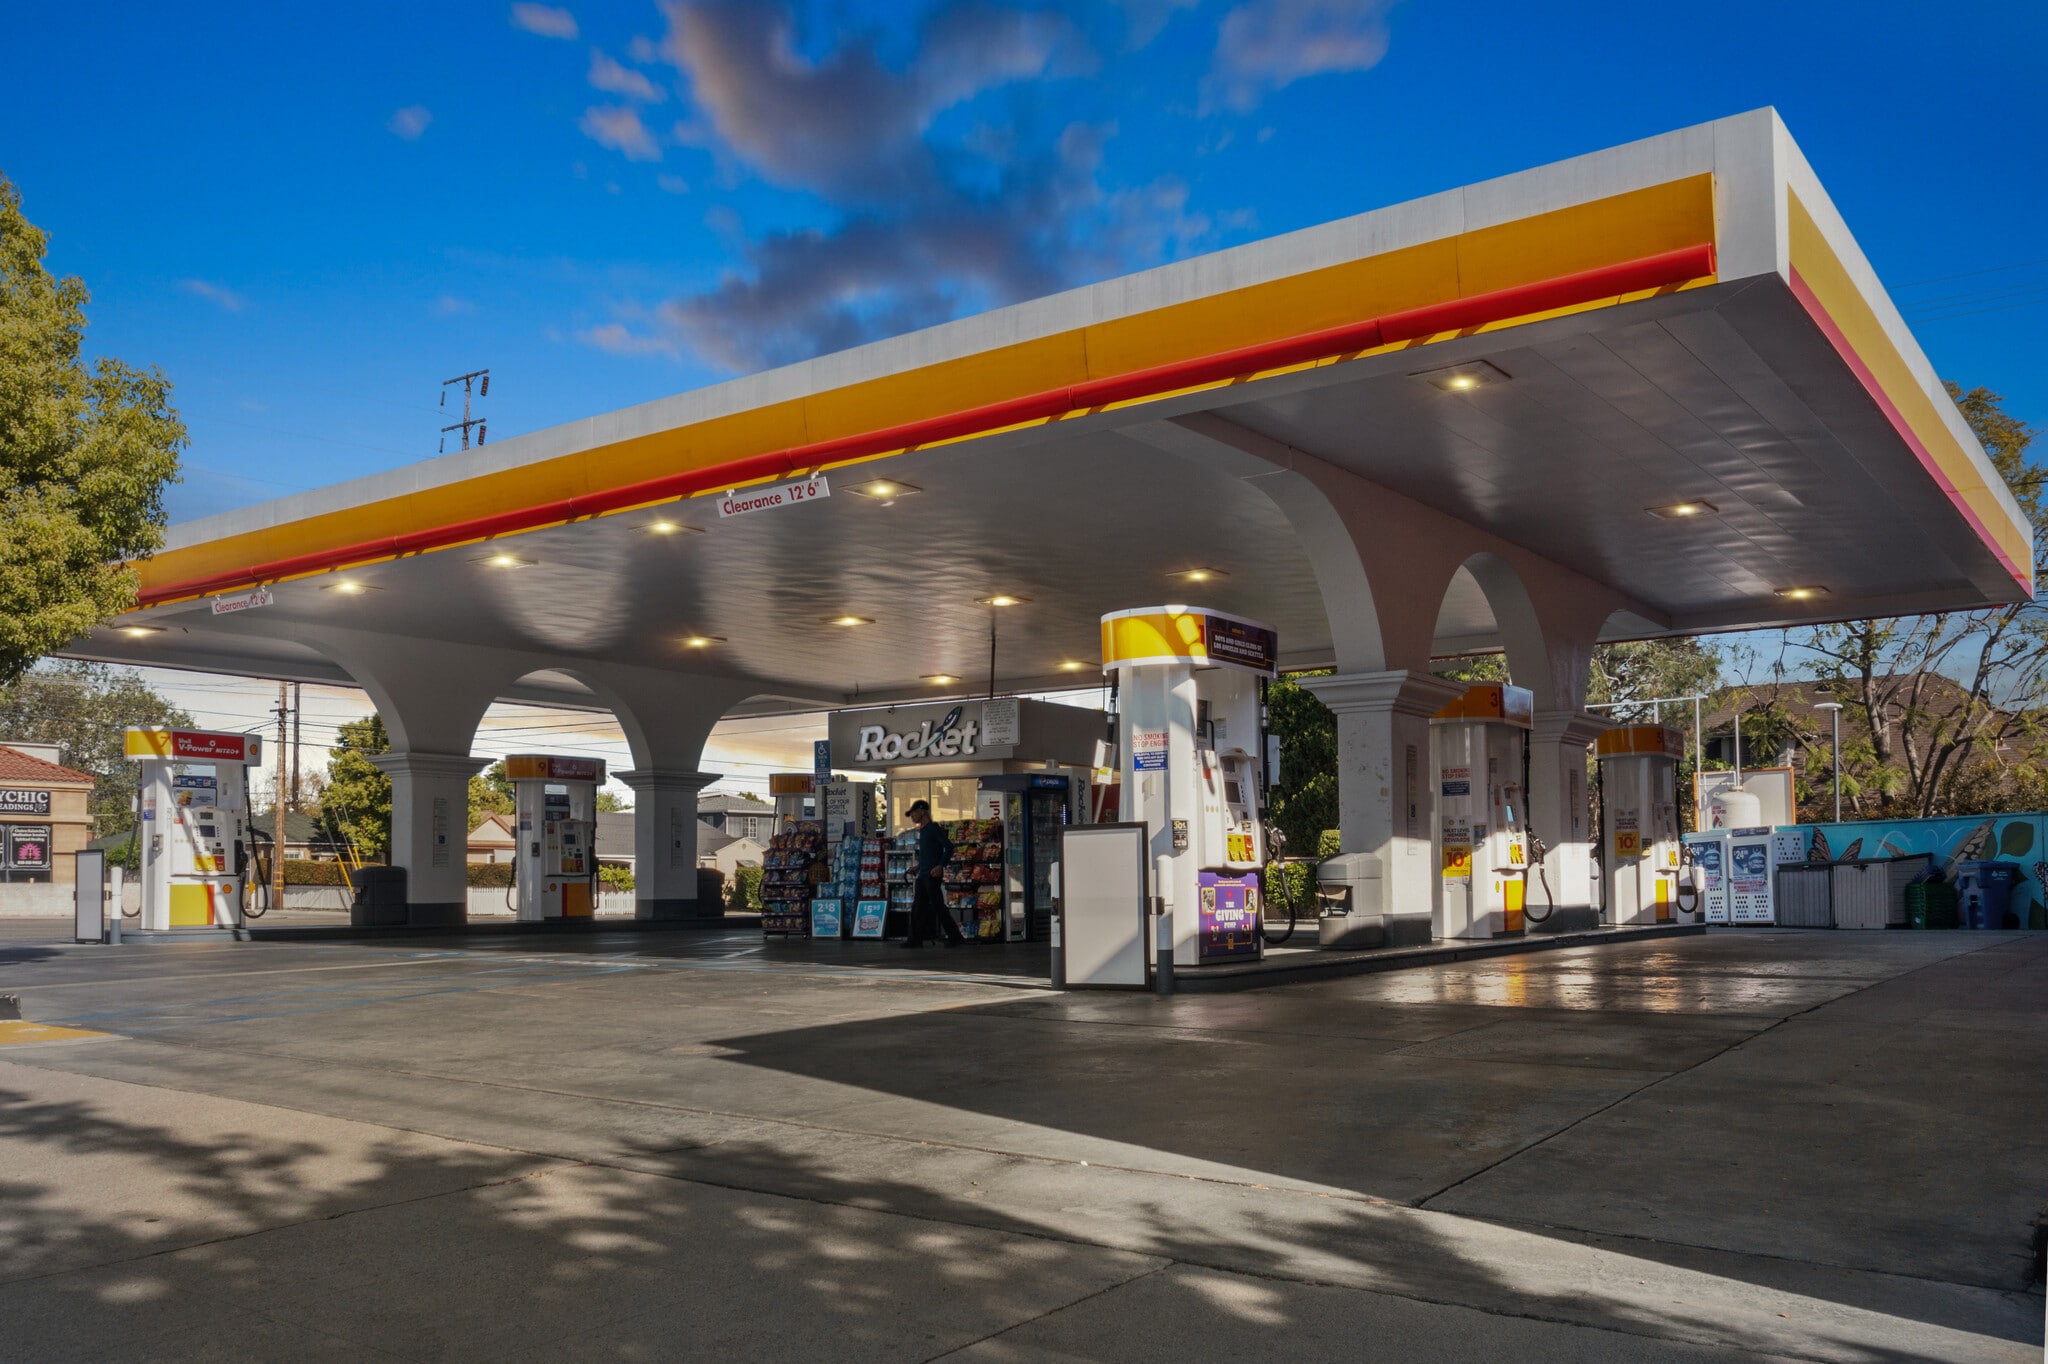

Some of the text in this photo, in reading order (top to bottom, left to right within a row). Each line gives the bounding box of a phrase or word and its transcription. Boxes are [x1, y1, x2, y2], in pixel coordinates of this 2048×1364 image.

[723, 481, 820, 515] Clearance 12' 6"
[215, 600, 249, 613] Clearance
[1490, 692, 1498, 707] 3
[160, 735, 170, 749] 7
[855, 718, 978, 762] Rocket
[178, 743, 213, 753] V-Power
[538, 762, 546, 772] 9
[1215, 909, 1245, 921] GIVING
